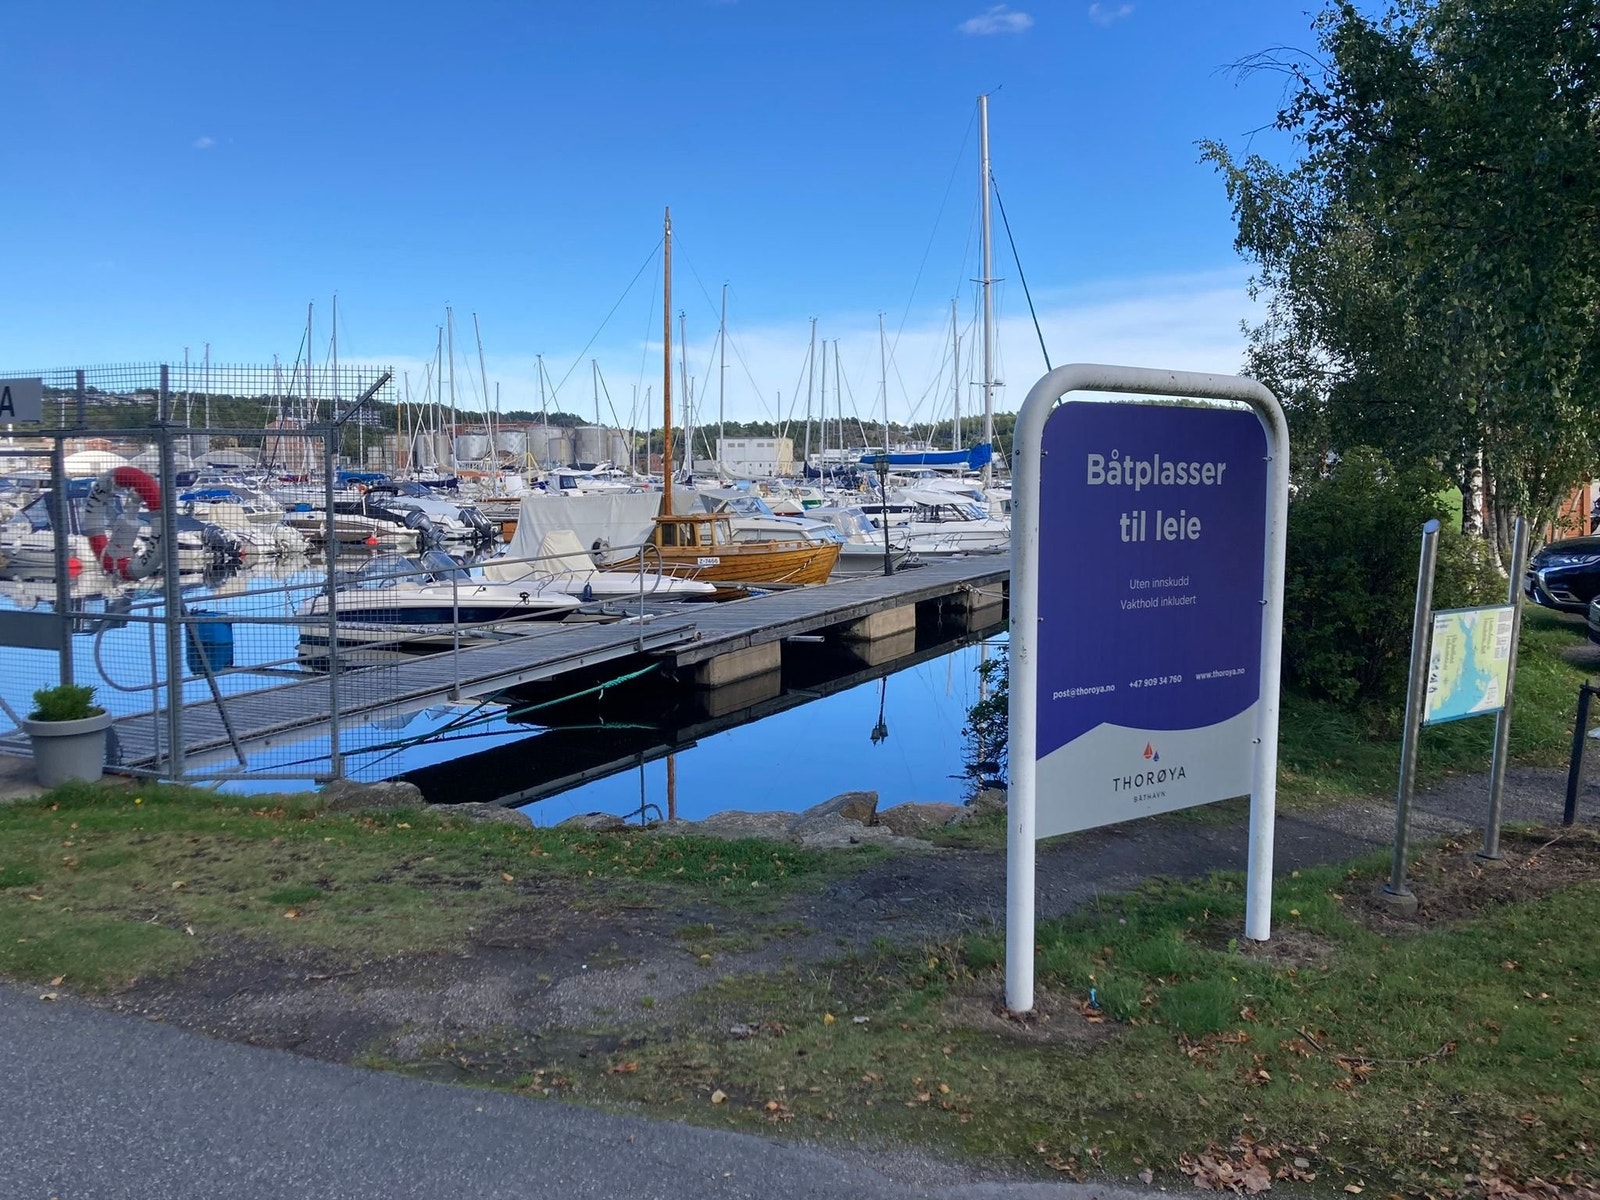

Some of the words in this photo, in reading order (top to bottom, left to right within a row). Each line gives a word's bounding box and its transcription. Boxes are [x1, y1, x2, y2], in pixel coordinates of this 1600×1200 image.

[0, 386, 15, 417] A
[1087, 449, 1226, 491] Båtplasser
[1120, 510, 1146, 542] til
[1156, 509, 1201, 541] leie
[1129, 579, 1150, 589] Uten
[1152, 576, 1189, 588] innskudd
[1120, 597, 1158, 610] Vakthold
[1160, 595, 1196, 607] inkludert
[1129, 680, 1142, 688] +47
[1143, 678, 1158, 687] 909
[1159, 676, 1168, 685] 34
[1169, 674, 1183, 683] 760
[1195, 667, 1245, 680] www.thoroya.no
[1053, 684, 1115, 700] post@thoroya.no
[1112, 766, 1186, 792] THORØYA
